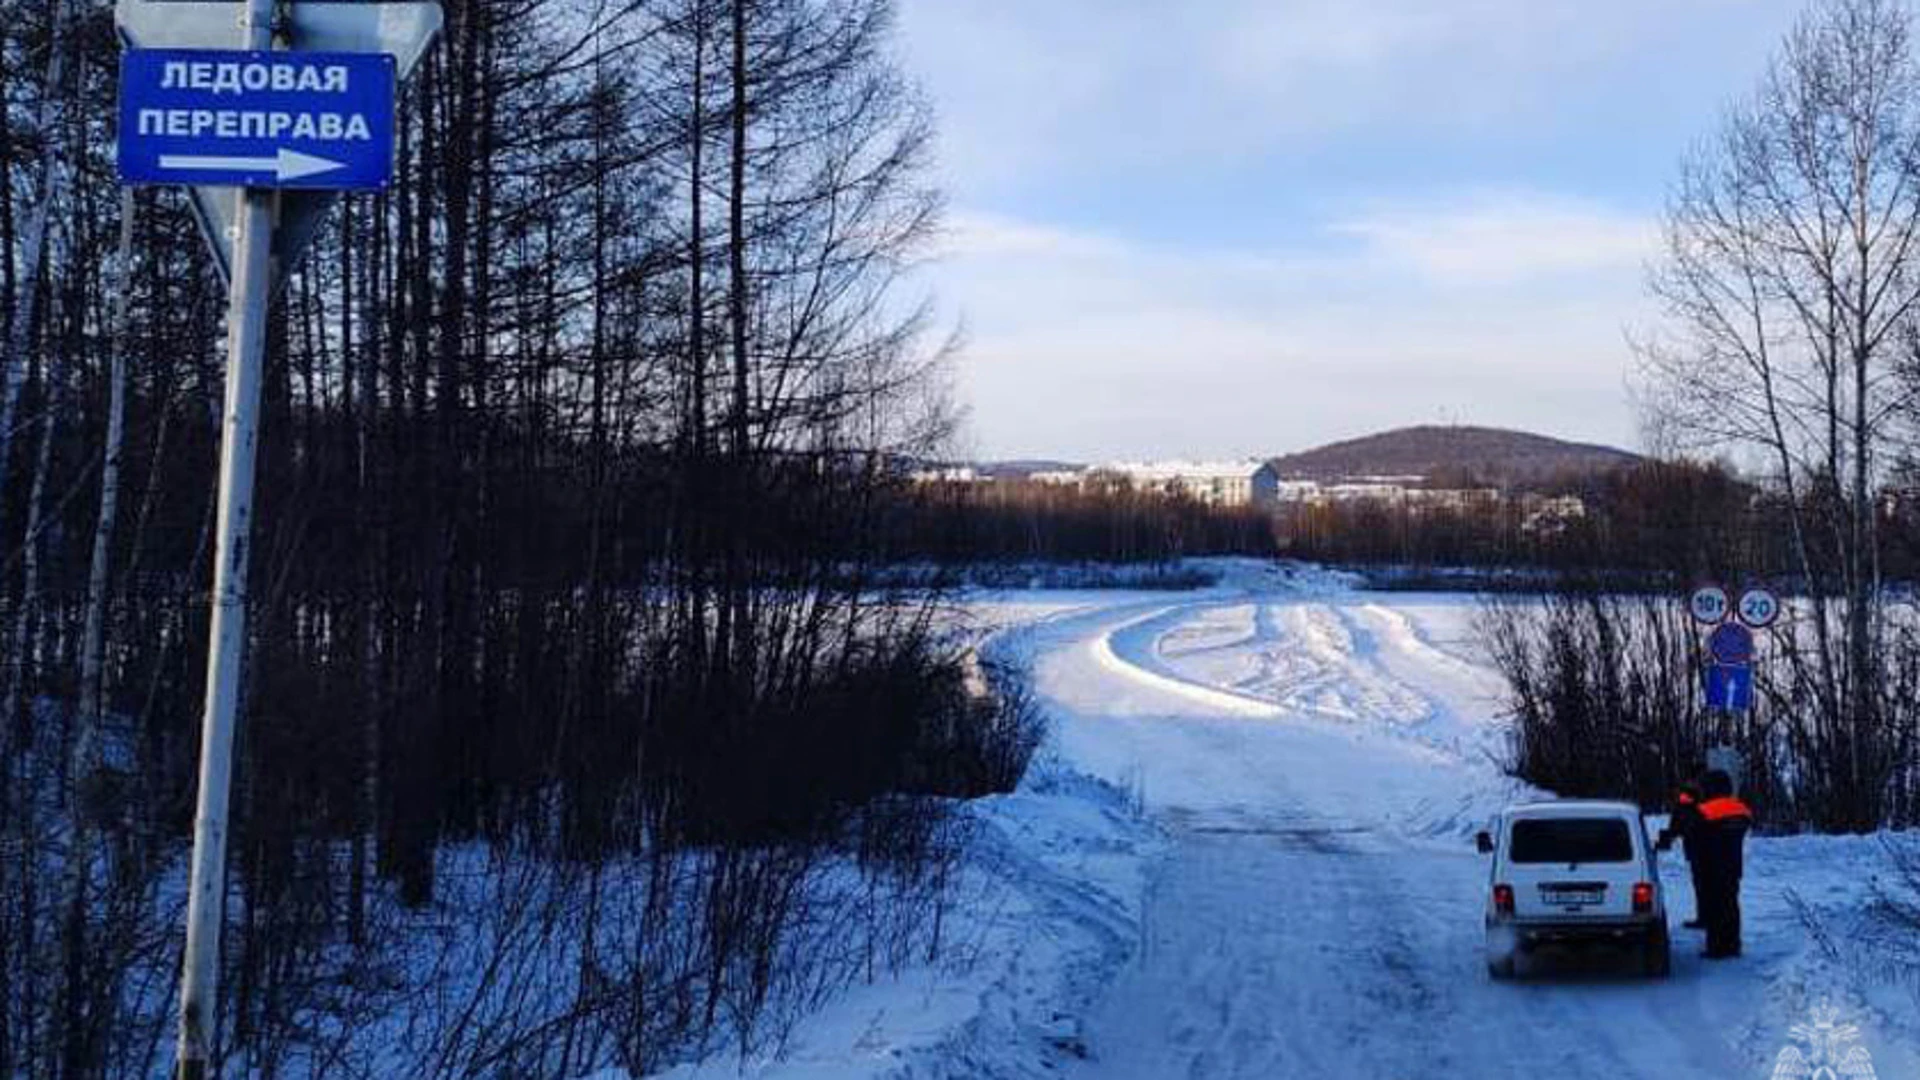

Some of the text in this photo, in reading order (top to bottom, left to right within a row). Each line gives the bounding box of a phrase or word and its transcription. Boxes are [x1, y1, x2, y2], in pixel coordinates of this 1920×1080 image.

[160, 61, 349, 95] ЛЕДОВАЯ
[138, 109, 372, 140] ПЕРЕПРАВА
[1745, 600, 1771, 616] 20
